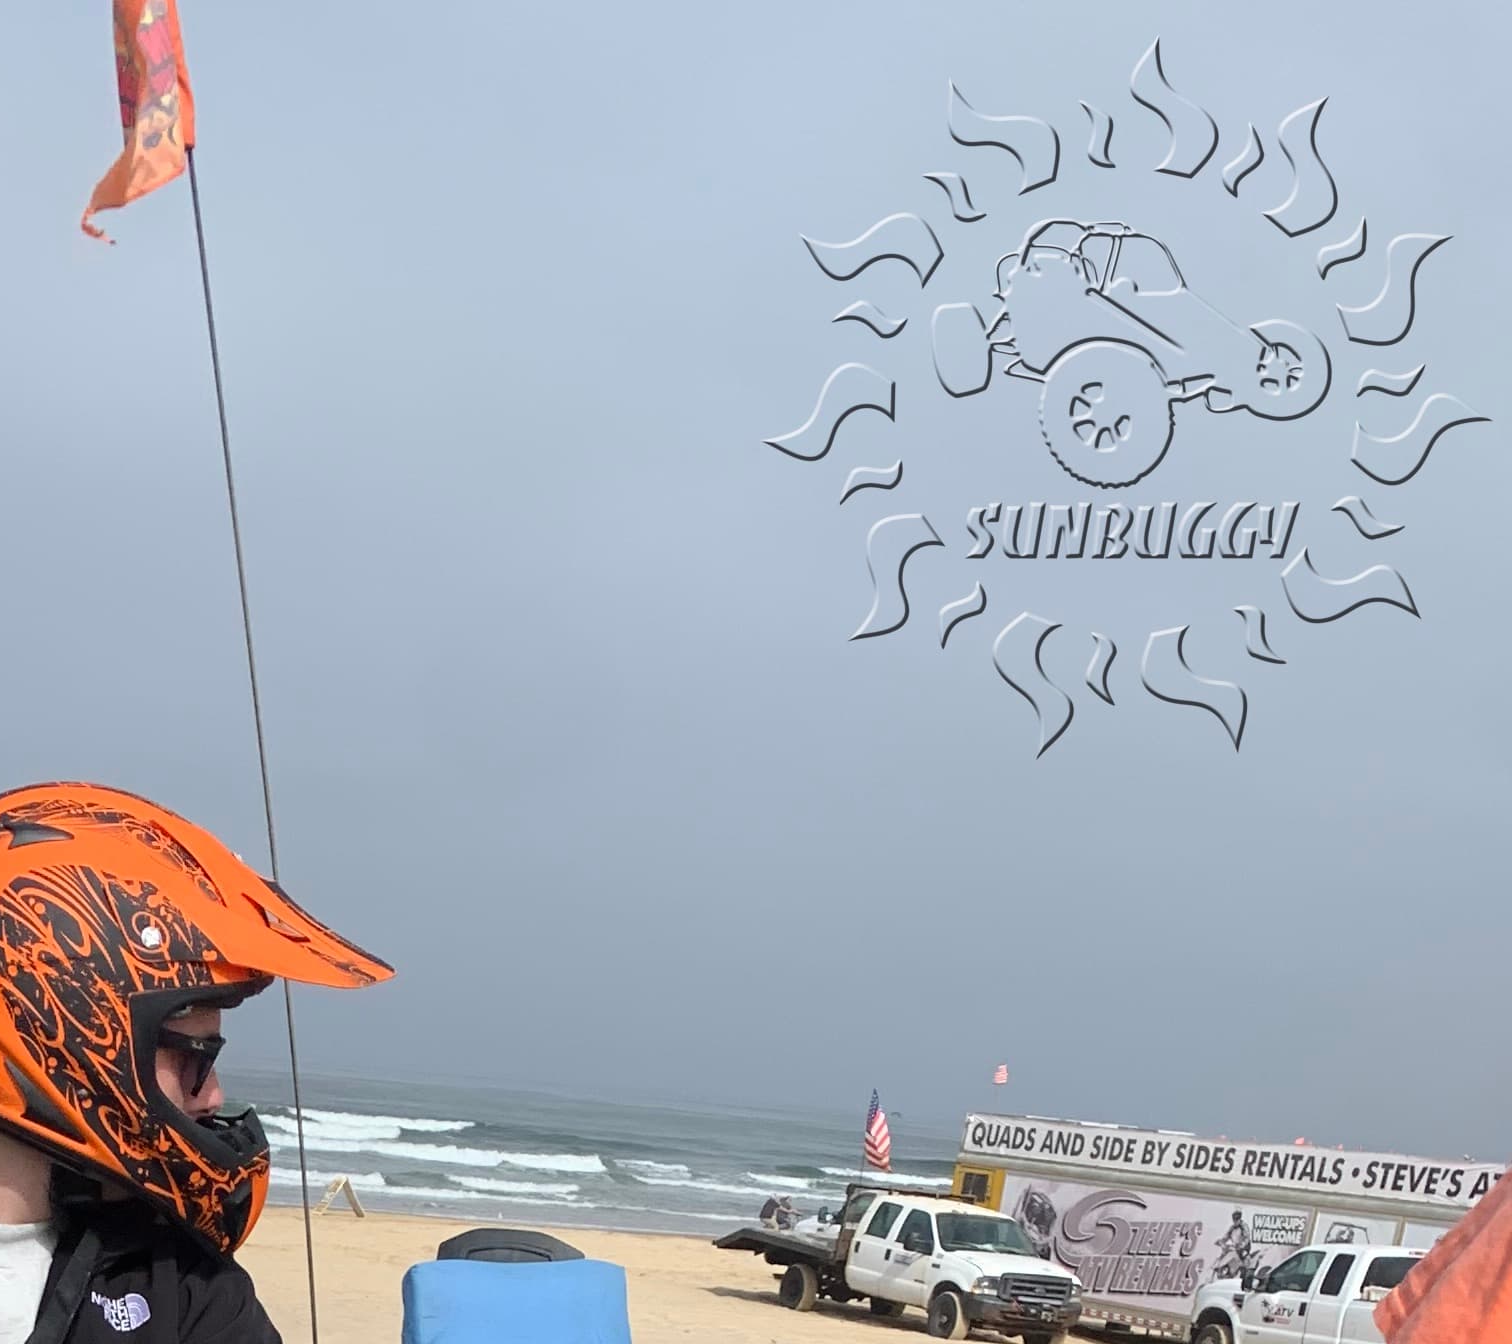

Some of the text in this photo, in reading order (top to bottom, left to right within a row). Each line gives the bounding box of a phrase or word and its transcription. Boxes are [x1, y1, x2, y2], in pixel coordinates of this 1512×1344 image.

[971, 1122, 1504, 1199] QUADS AND SIDE BY SIDES RENTALS STEVE'S A
[1251, 1229, 1302, 1246] WELCOME
[1108, 1256, 1204, 1297] RENTALS
